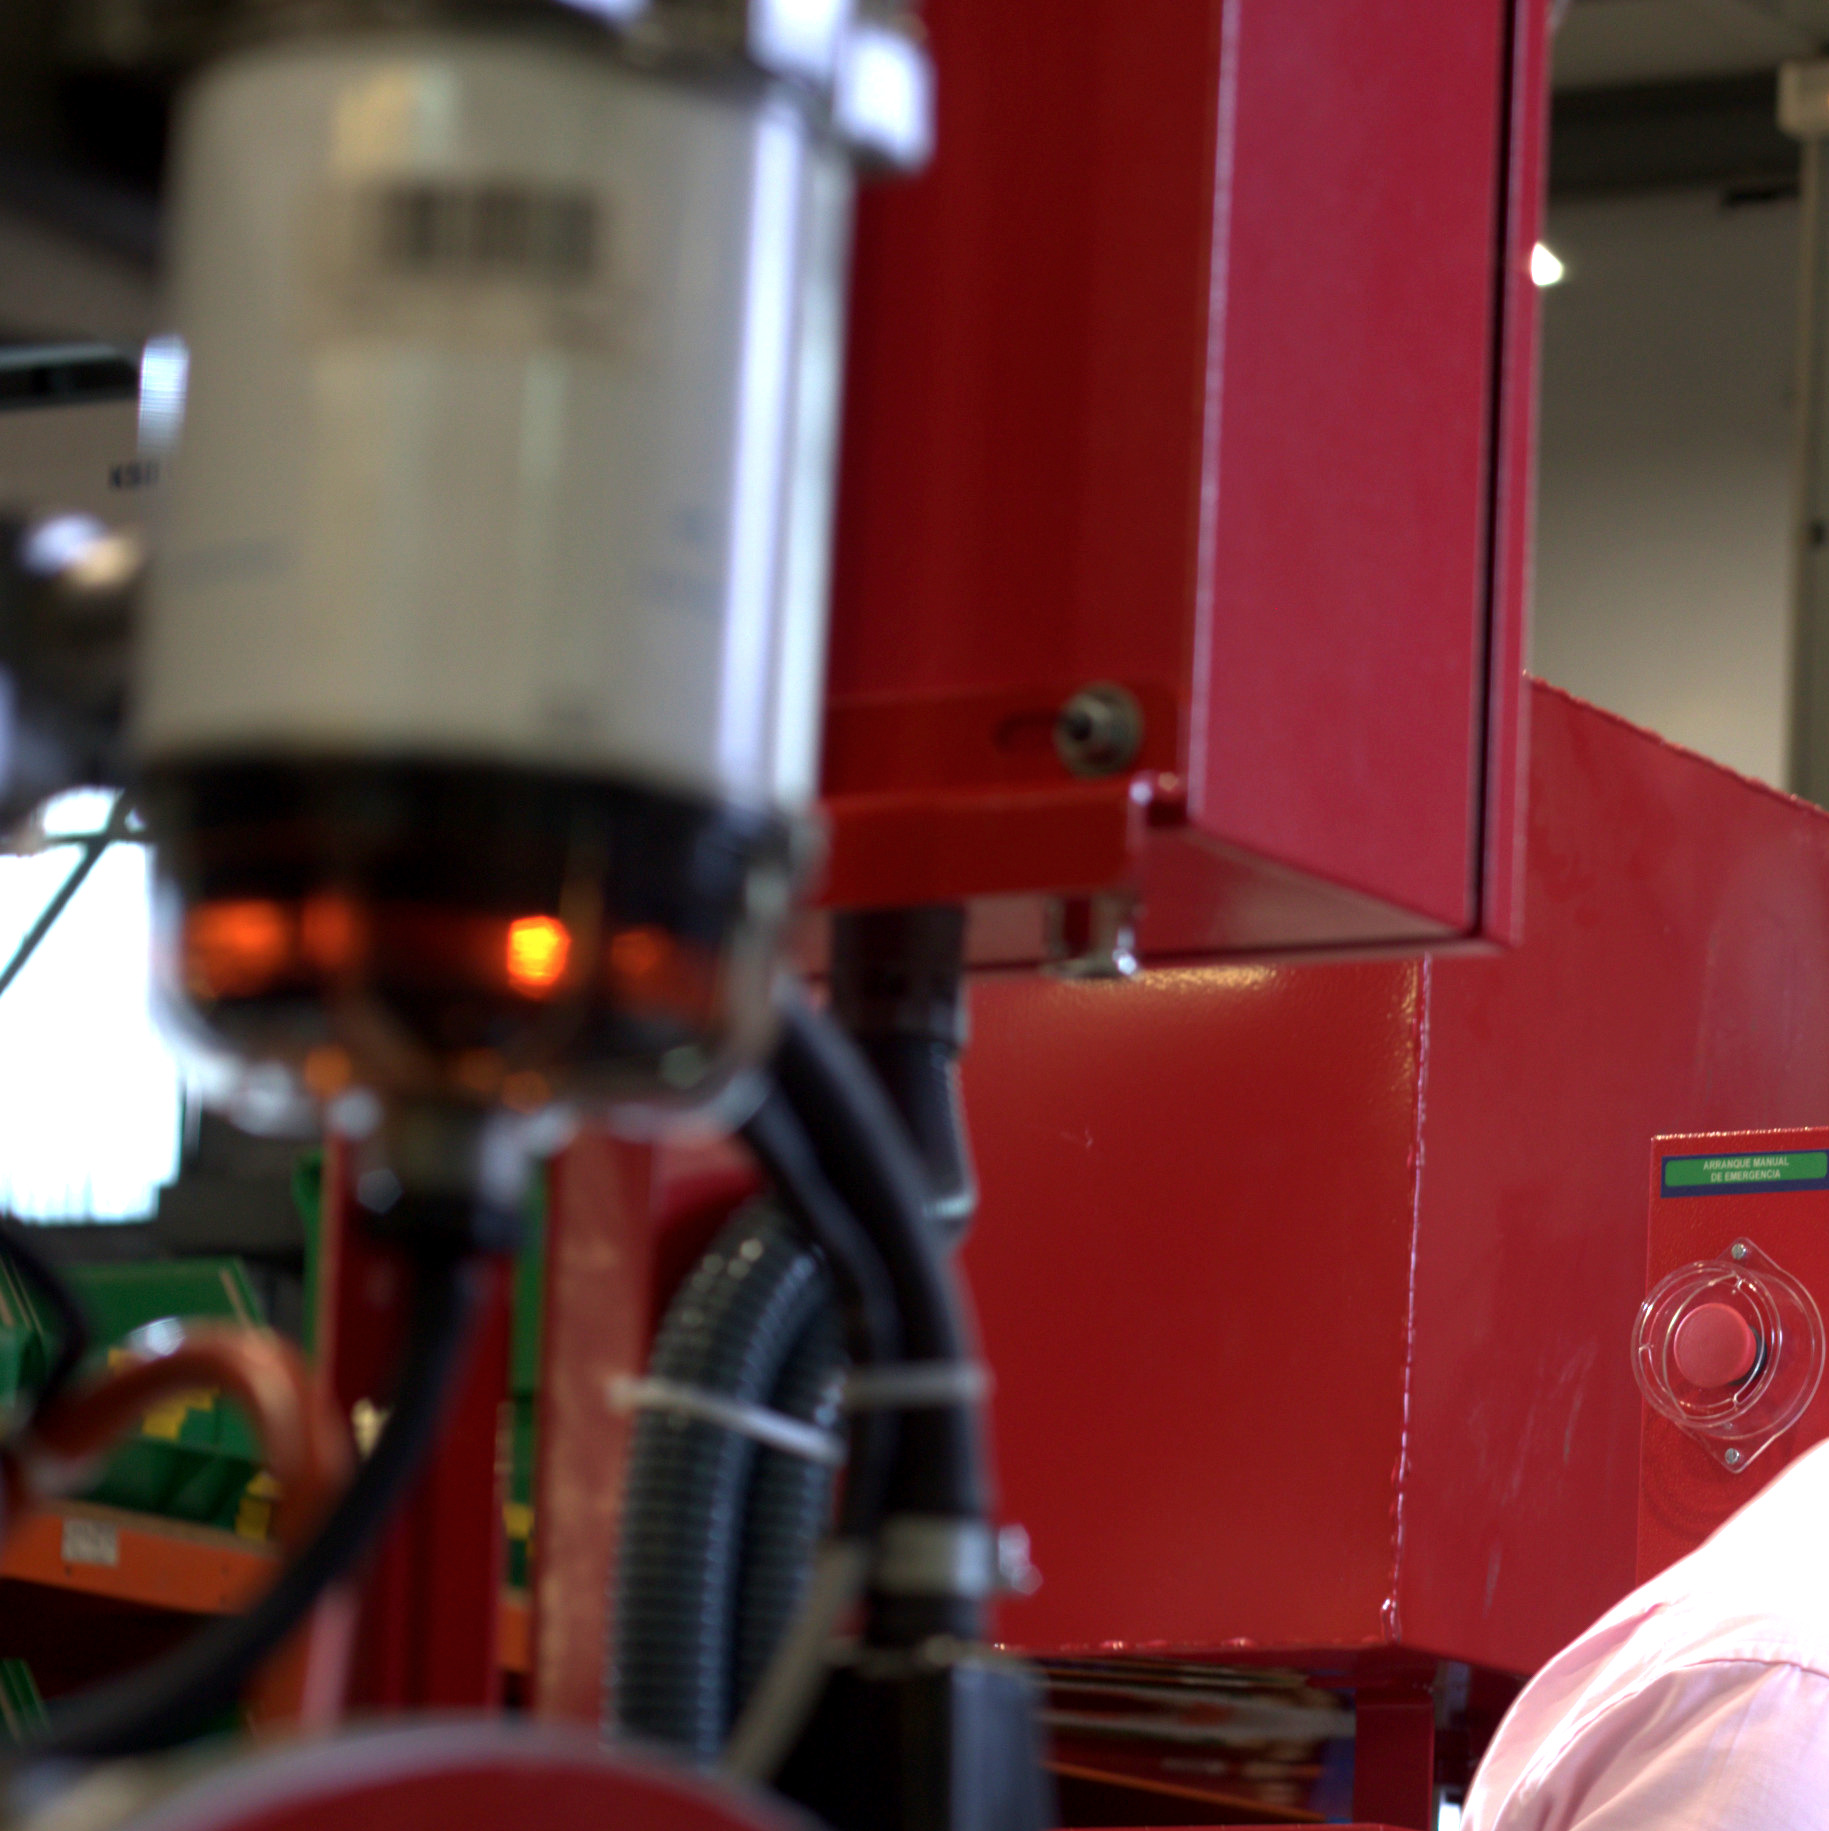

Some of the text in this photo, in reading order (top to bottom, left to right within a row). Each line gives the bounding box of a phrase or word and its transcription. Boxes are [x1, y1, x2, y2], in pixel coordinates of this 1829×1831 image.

[1703, 1156, 1790, 1170] ARRANQUE MANUAL
[1710, 1169, 1781, 1183] DE EMERGENCIA
